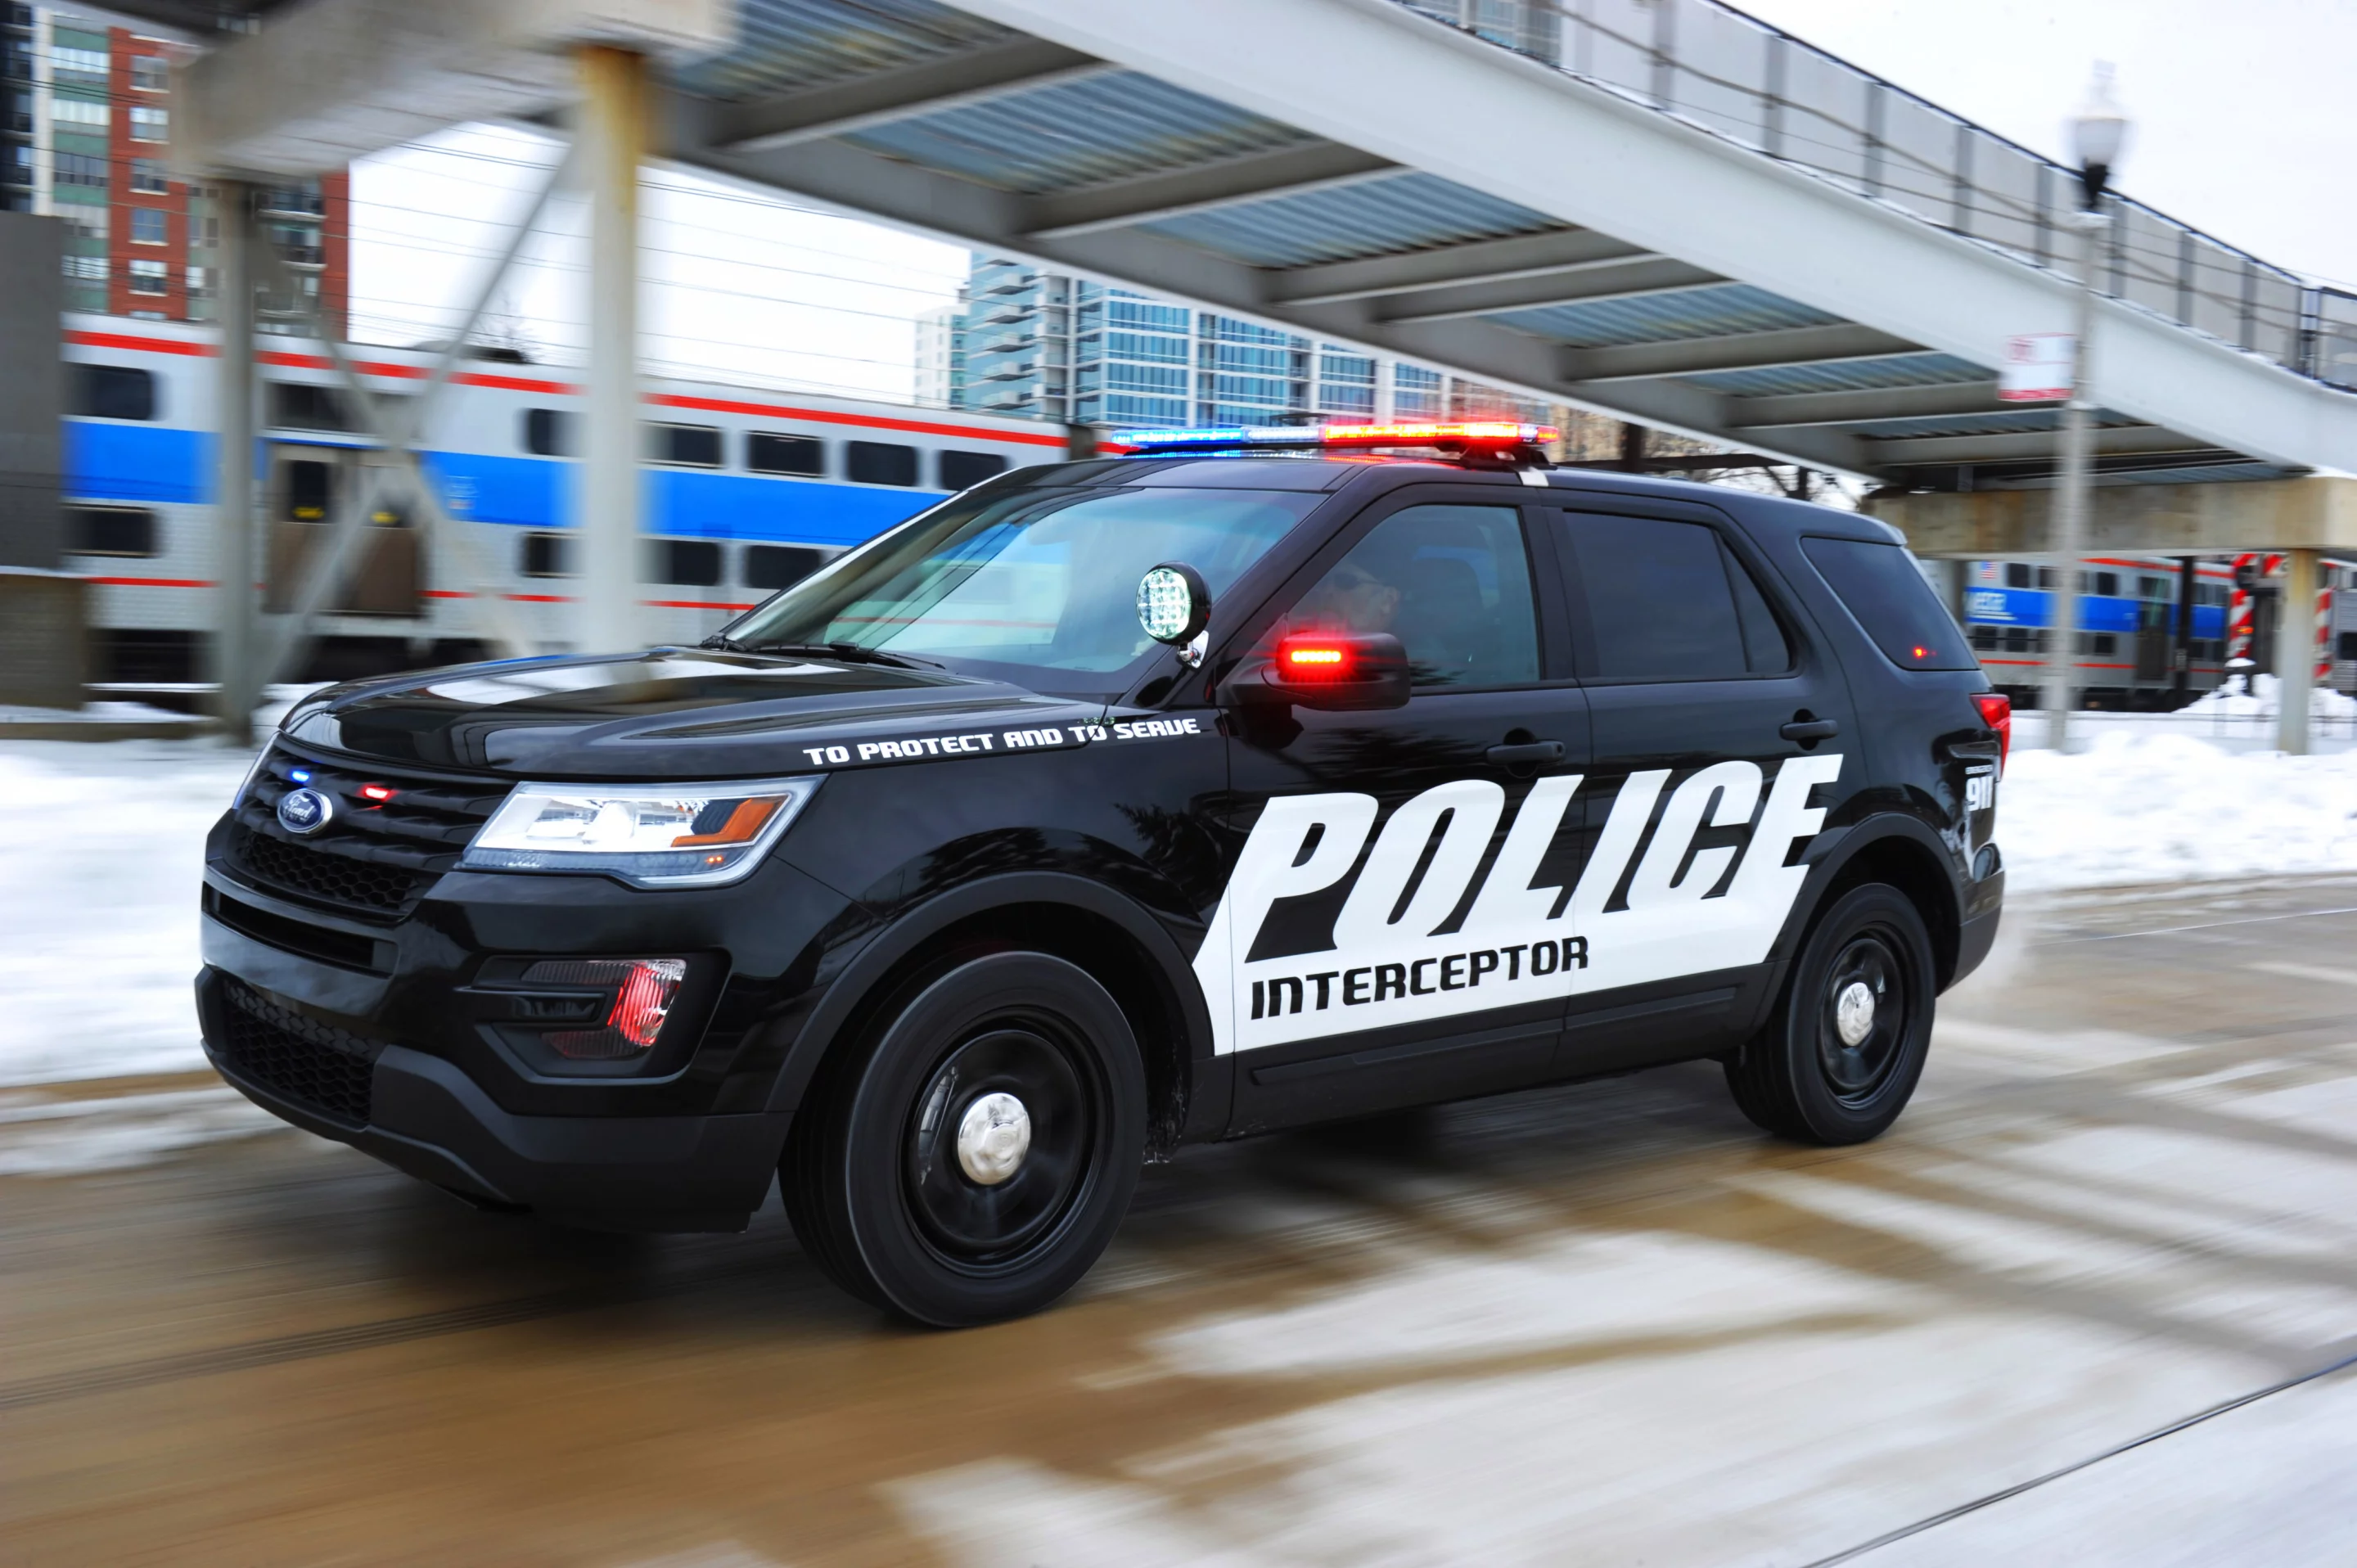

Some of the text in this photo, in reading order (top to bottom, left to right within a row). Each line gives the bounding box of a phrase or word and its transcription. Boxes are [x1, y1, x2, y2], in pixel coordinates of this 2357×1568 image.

[803, 718, 1201, 766] TO PROTECT AND TO SERVE
[284, 794, 318, 819] Ford
[1967, 775, 1994, 812] 911
[1206, 753, 1844, 964] POLICE
[1251, 935, 1589, 1020] INTERCEPTOR
